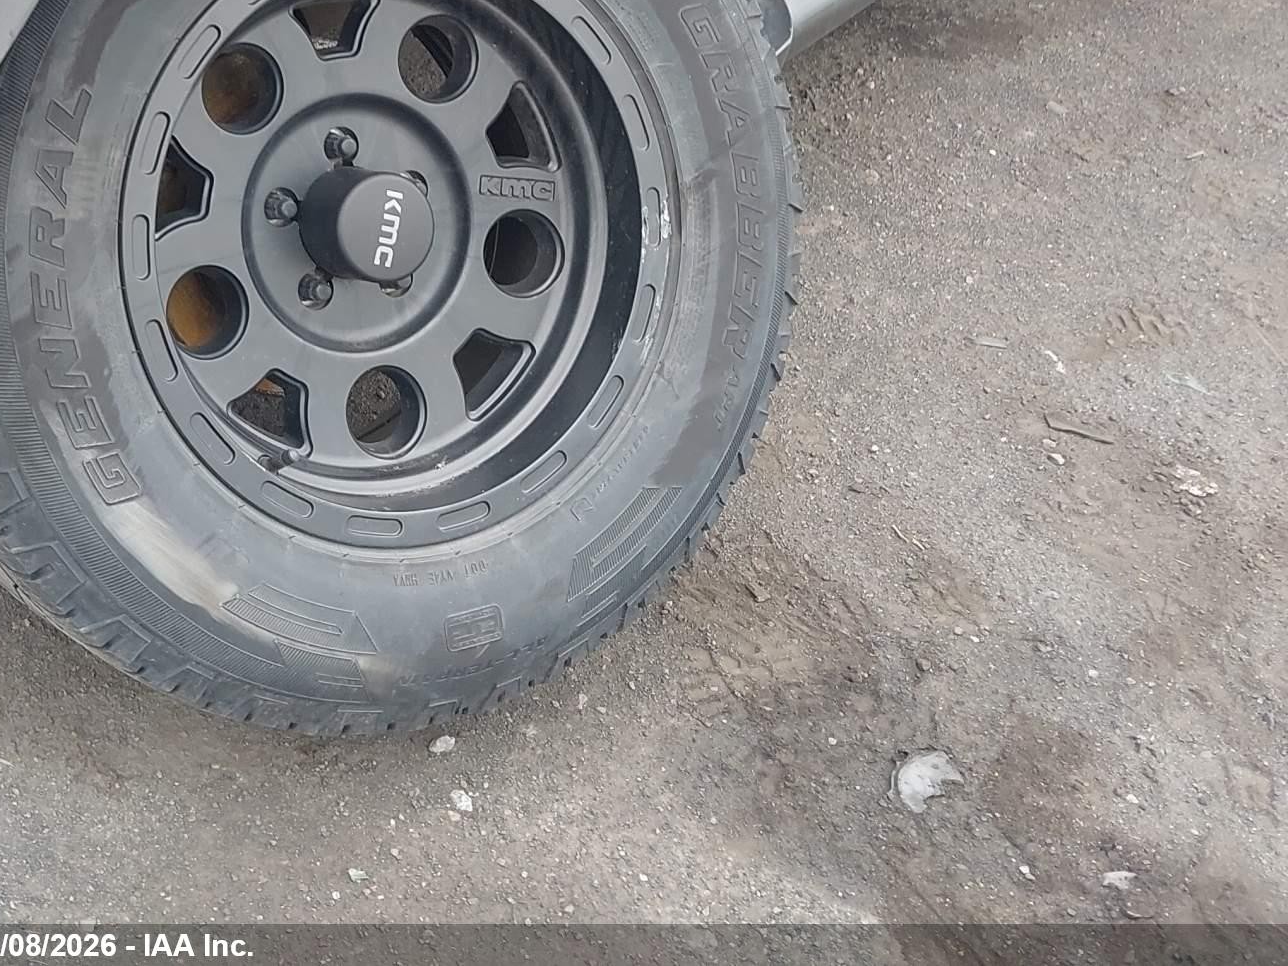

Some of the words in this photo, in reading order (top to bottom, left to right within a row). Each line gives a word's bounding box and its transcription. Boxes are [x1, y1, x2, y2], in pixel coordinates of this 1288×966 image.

[479, 174, 556, 202] KMC
[373, 189, 404, 268] KMC
[28, 87, 142, 505] GENERAL
